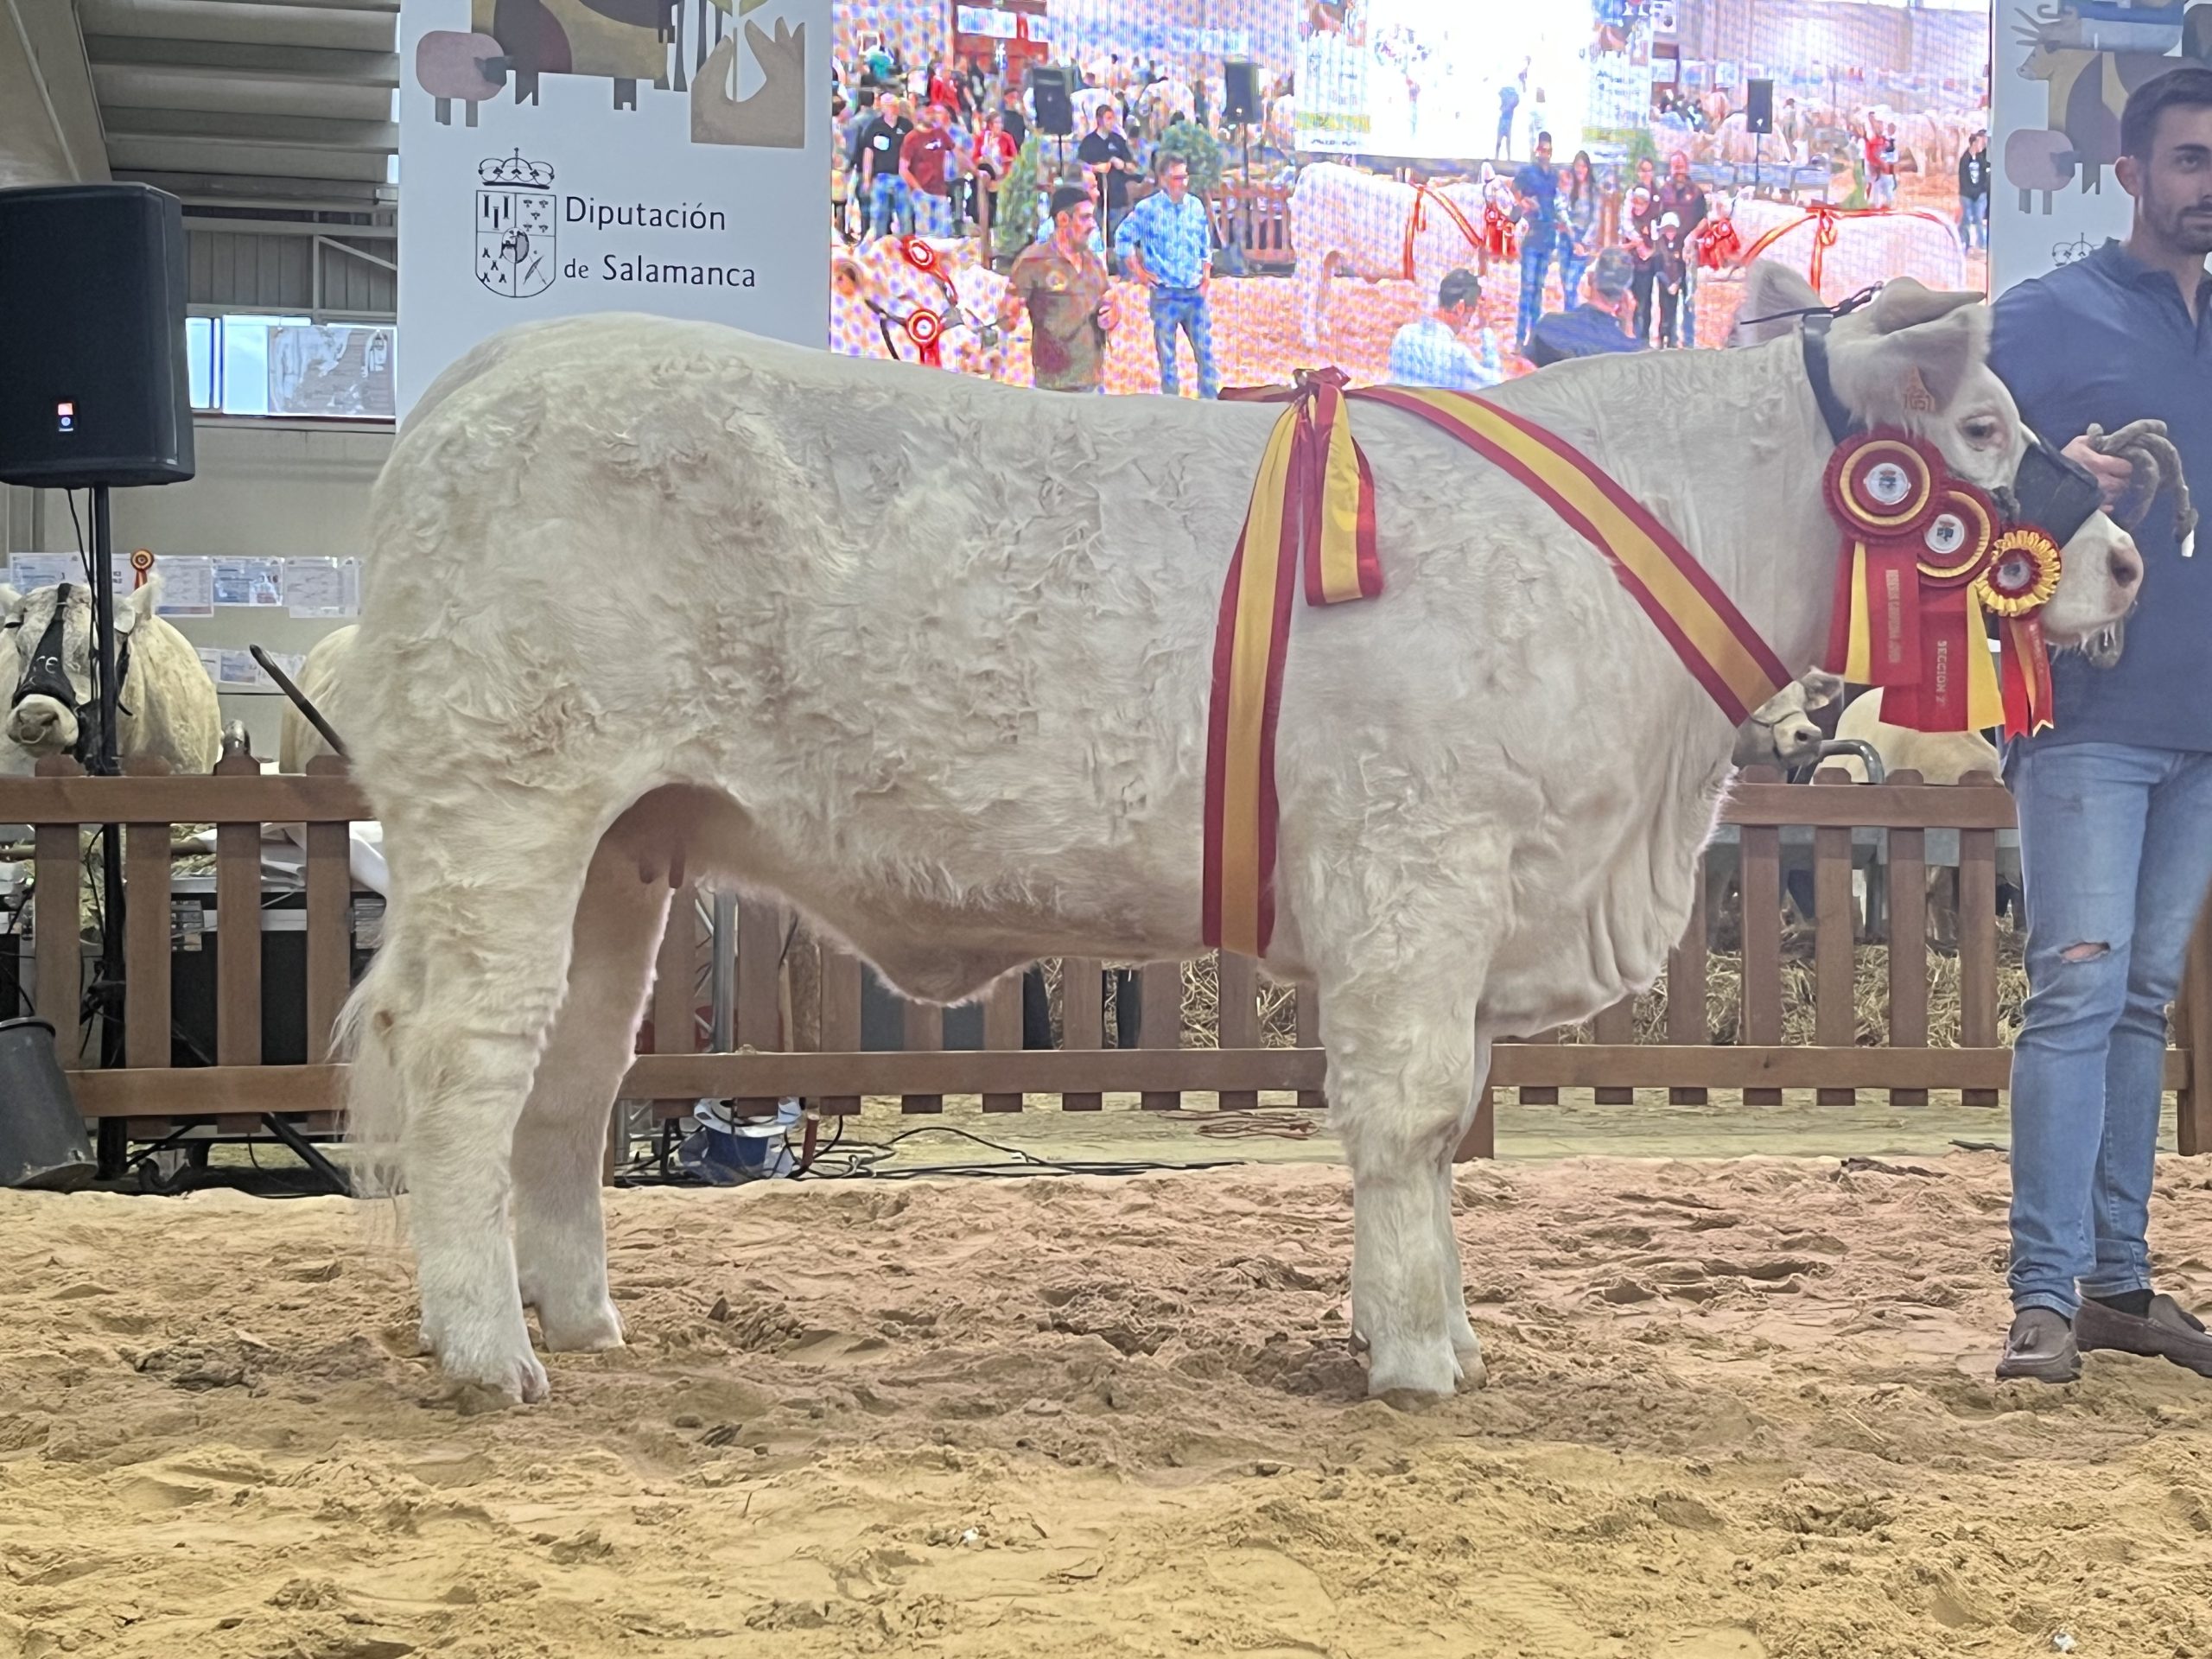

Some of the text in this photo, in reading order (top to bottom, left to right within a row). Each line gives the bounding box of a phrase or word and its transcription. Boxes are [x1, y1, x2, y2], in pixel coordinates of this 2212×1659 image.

[565, 195, 726, 231] Diputación
[564, 254, 755, 288] de Salamanca
